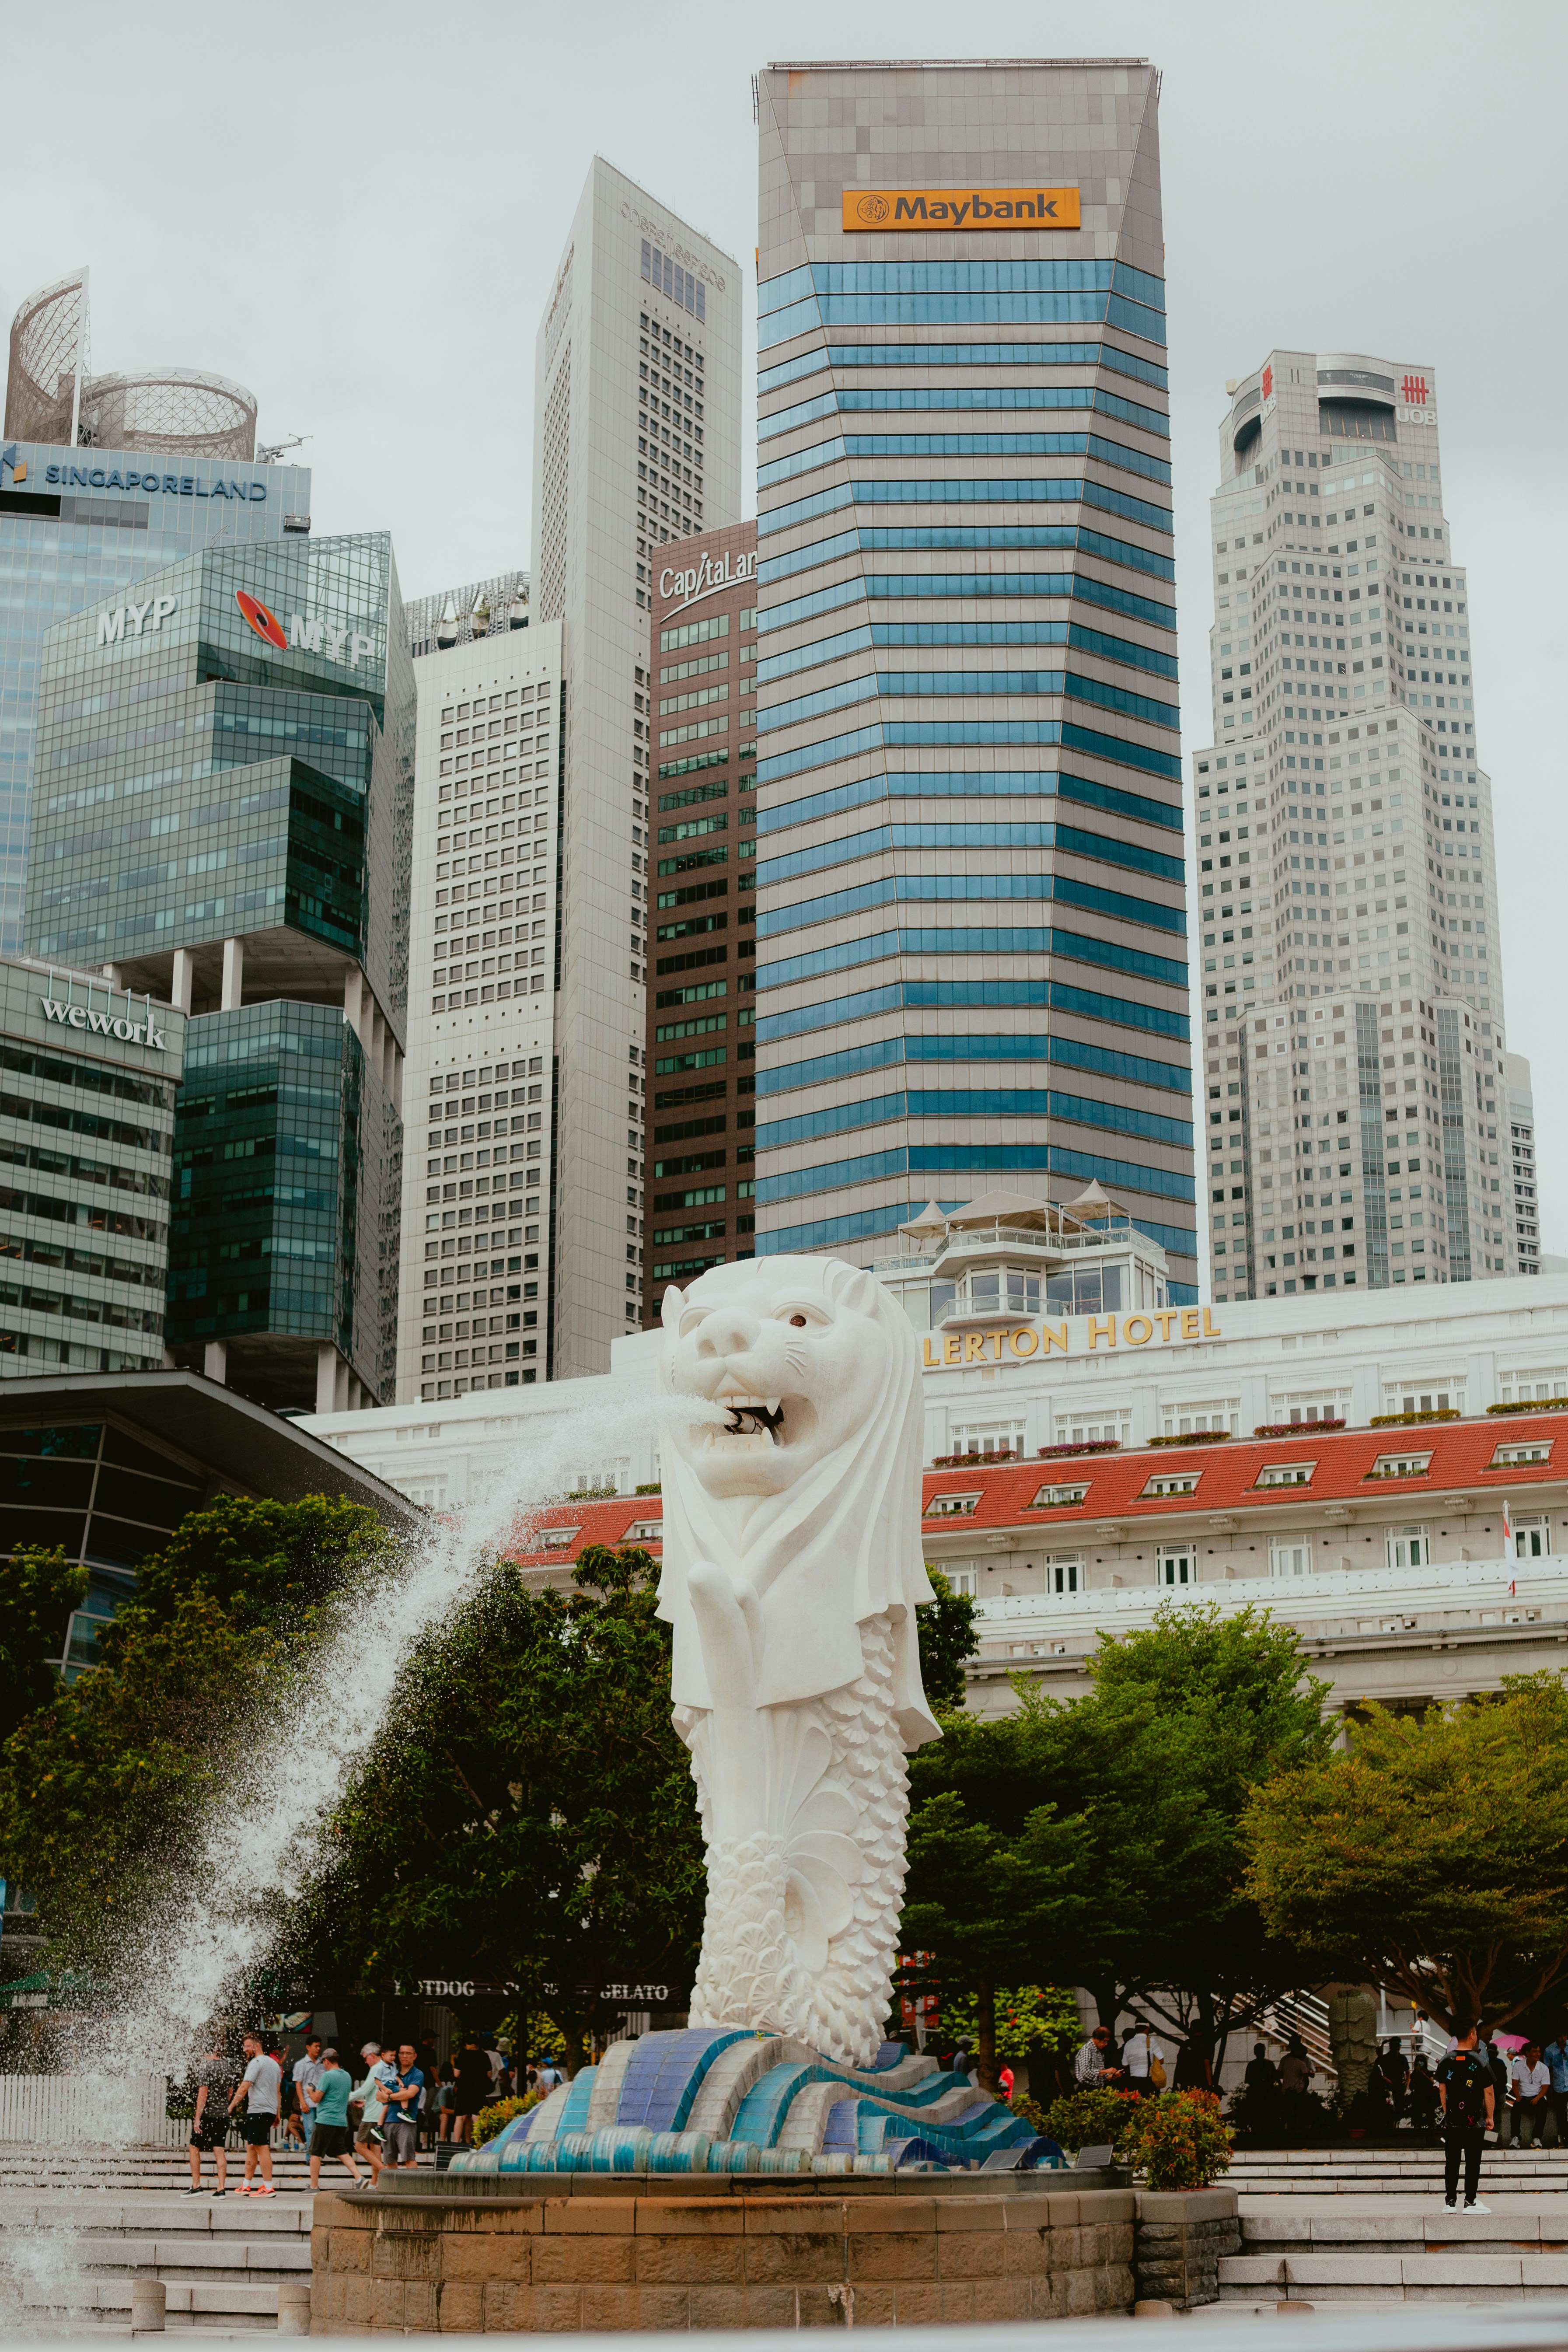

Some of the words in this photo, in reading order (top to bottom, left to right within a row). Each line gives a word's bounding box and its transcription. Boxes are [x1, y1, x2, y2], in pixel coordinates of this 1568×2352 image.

[894, 193, 1059, 225] Maybank
[1260, 394, 1276, 425] UOB
[1396, 406, 1437, 426] UOB
[97, 594, 178, 646] MYP
[290, 613, 375, 665] MYP
[39, 996, 168, 1050] wework
[923, 1323, 1068, 1366] LERTON
[1088, 1307, 1221, 1349] HOTEL
[600, 1984, 669, 2000] GELATO
